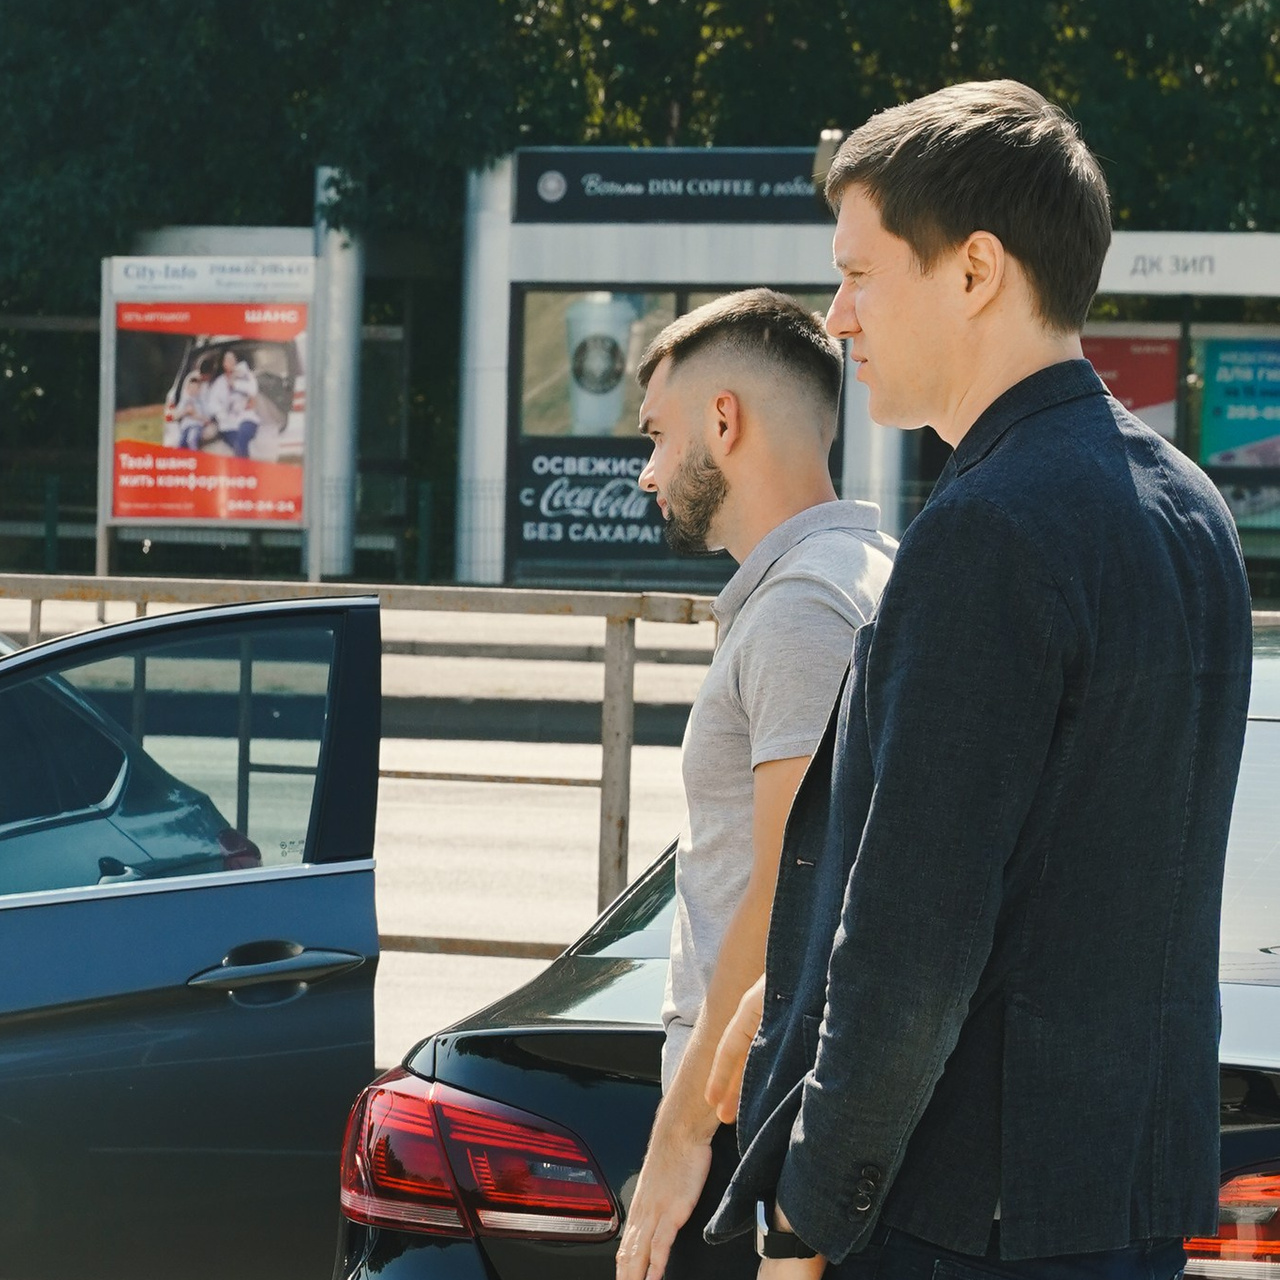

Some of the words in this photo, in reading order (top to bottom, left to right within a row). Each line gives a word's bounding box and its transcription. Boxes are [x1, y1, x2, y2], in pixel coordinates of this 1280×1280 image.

[648, 178, 684, 196] DIM
[686, 178, 755, 197] COFFEE
[123, 263, 198, 282] City-Info
[1130, 253, 1164, 277] ДК
[1171, 254, 1216, 276] ЗИП
[244, 309, 299, 324] ШАНС
[119, 453, 154, 470] Твой
[155, 457, 198, 471] шанс
[119, 474, 155, 488] жить
[156, 472, 258, 492] комфортнее
[523, 521, 564, 541] БЕЗ
[569, 522, 663, 544] САХАРА!
